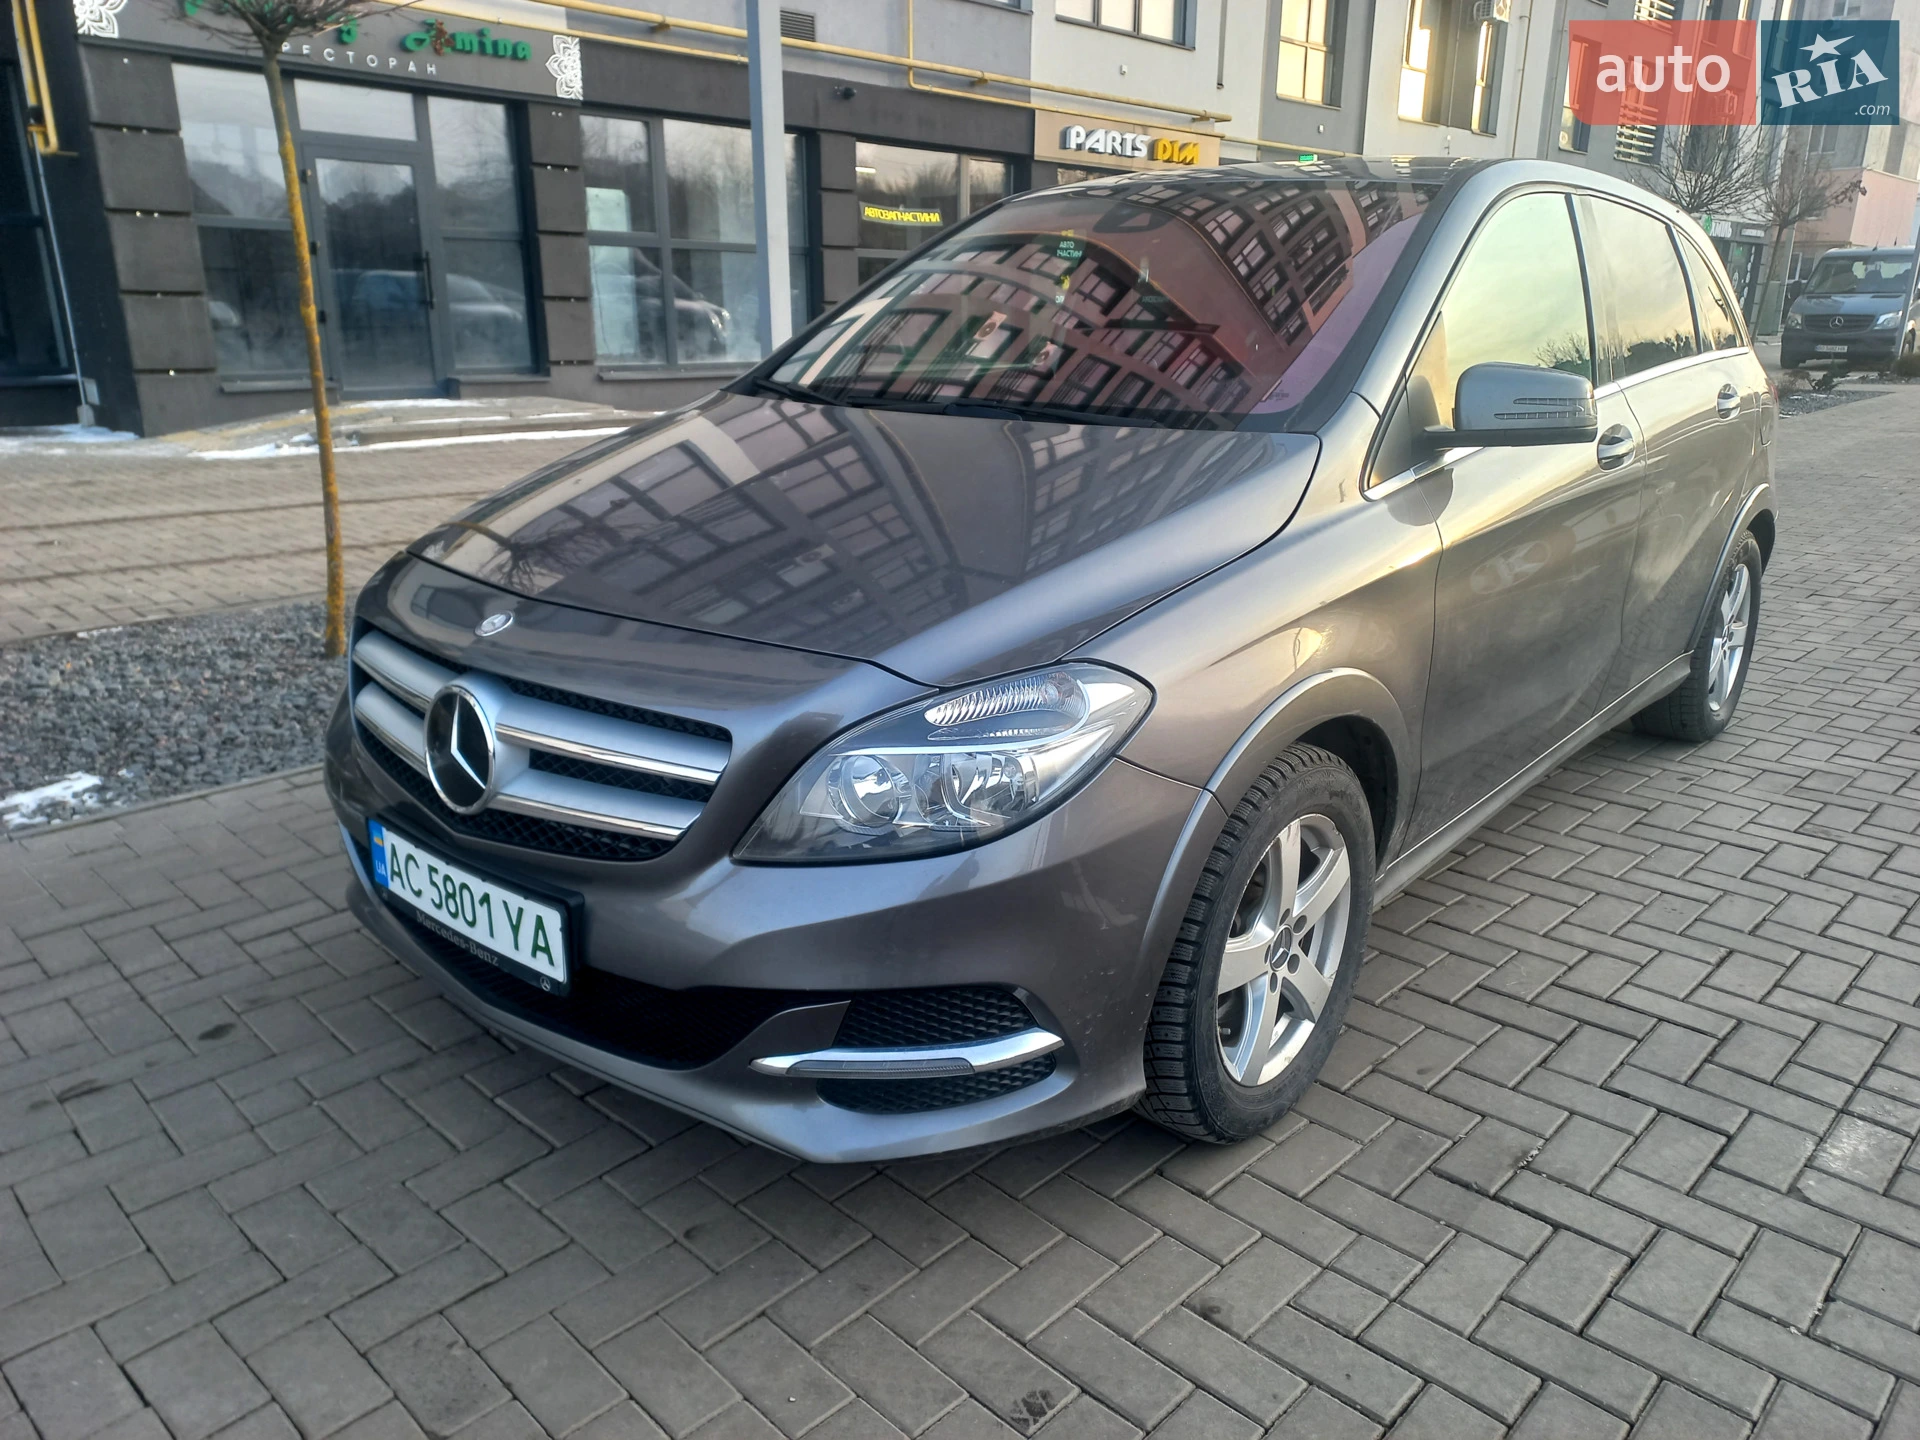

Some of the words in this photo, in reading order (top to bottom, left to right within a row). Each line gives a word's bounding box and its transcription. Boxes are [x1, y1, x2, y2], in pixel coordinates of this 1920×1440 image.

[281, 41, 437, 76] РЕСТОРАН
[1066, 125, 1151, 158] PARTS
[375, 860, 387, 877] UA
[390, 842, 423, 898] AC
[427, 863, 494, 939] 5801
[502, 899, 555, 967] YA
[416, 910, 499, 967] Mercedes-Benz
